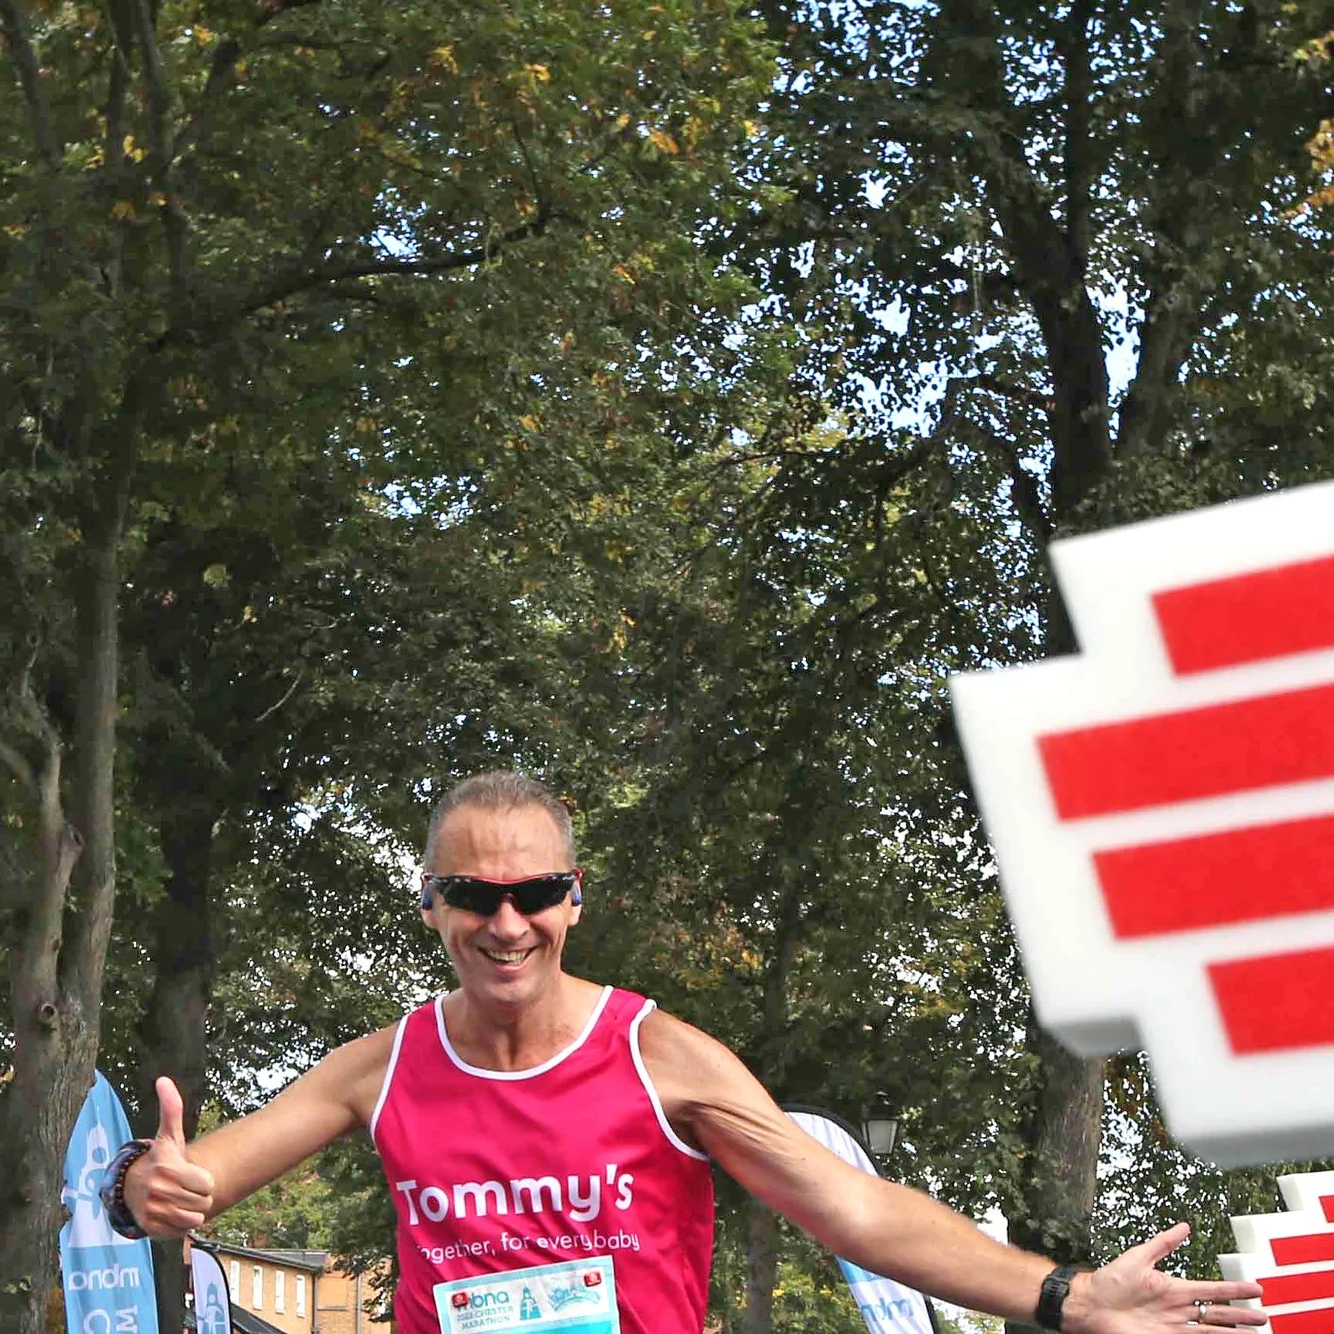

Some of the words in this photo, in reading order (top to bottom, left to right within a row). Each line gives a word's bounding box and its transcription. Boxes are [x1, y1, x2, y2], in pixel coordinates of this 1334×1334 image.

[395, 1164, 634, 1226] Tommy's
[418, 1237, 497, 1264] ogether,
[500, 1231, 531, 1252] for
[536, 1232, 593, 1253] every
[593, 1229, 641, 1252] baby
